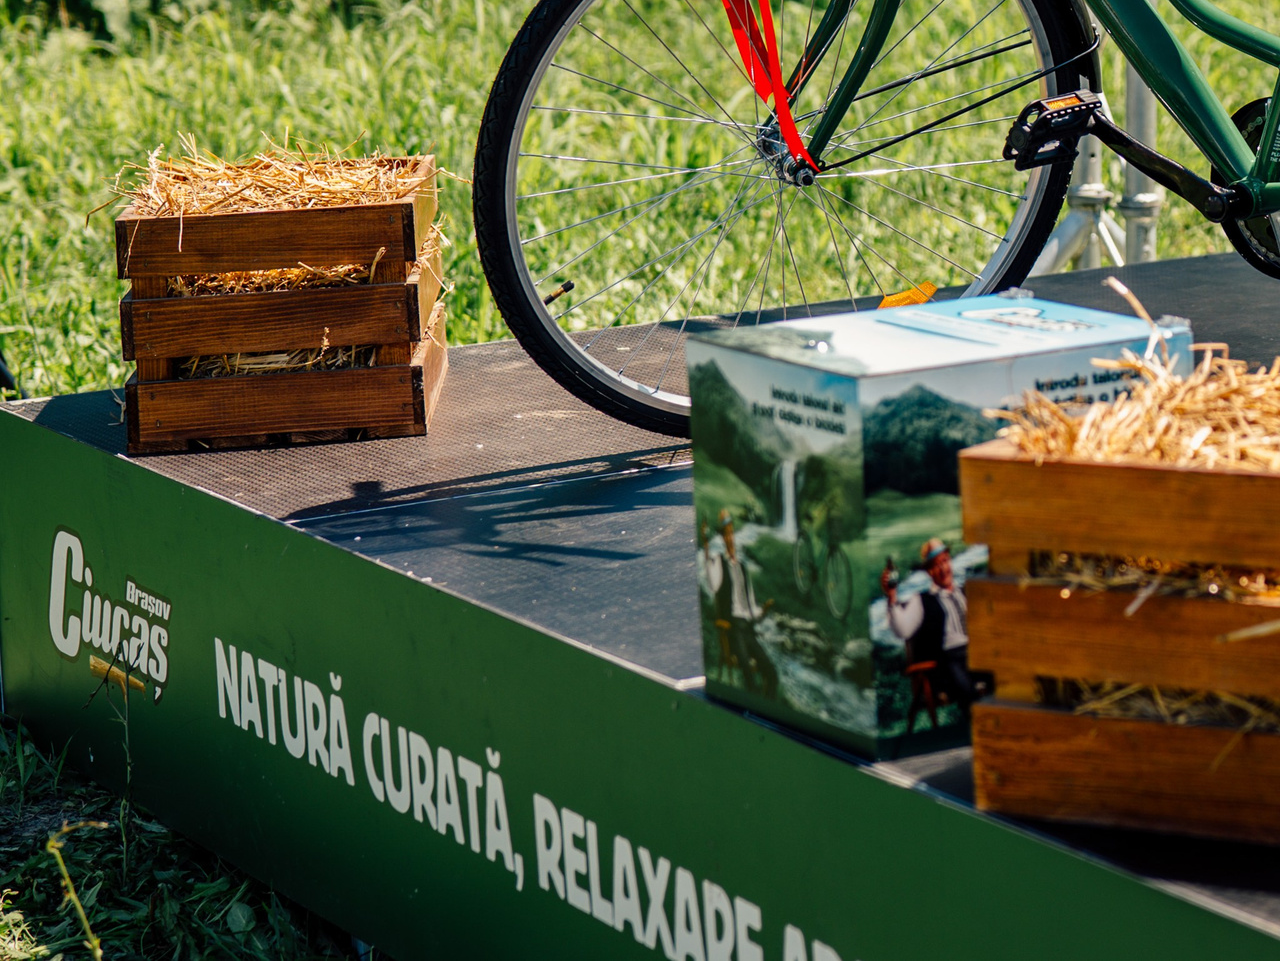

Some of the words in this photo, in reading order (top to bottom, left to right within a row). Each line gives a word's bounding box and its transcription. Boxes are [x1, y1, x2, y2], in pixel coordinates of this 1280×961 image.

[126, 580, 171, 620] Brașov
[214, 636, 355, 787] NATURĂ
[363, 712, 524, 892] CURATĂ,
